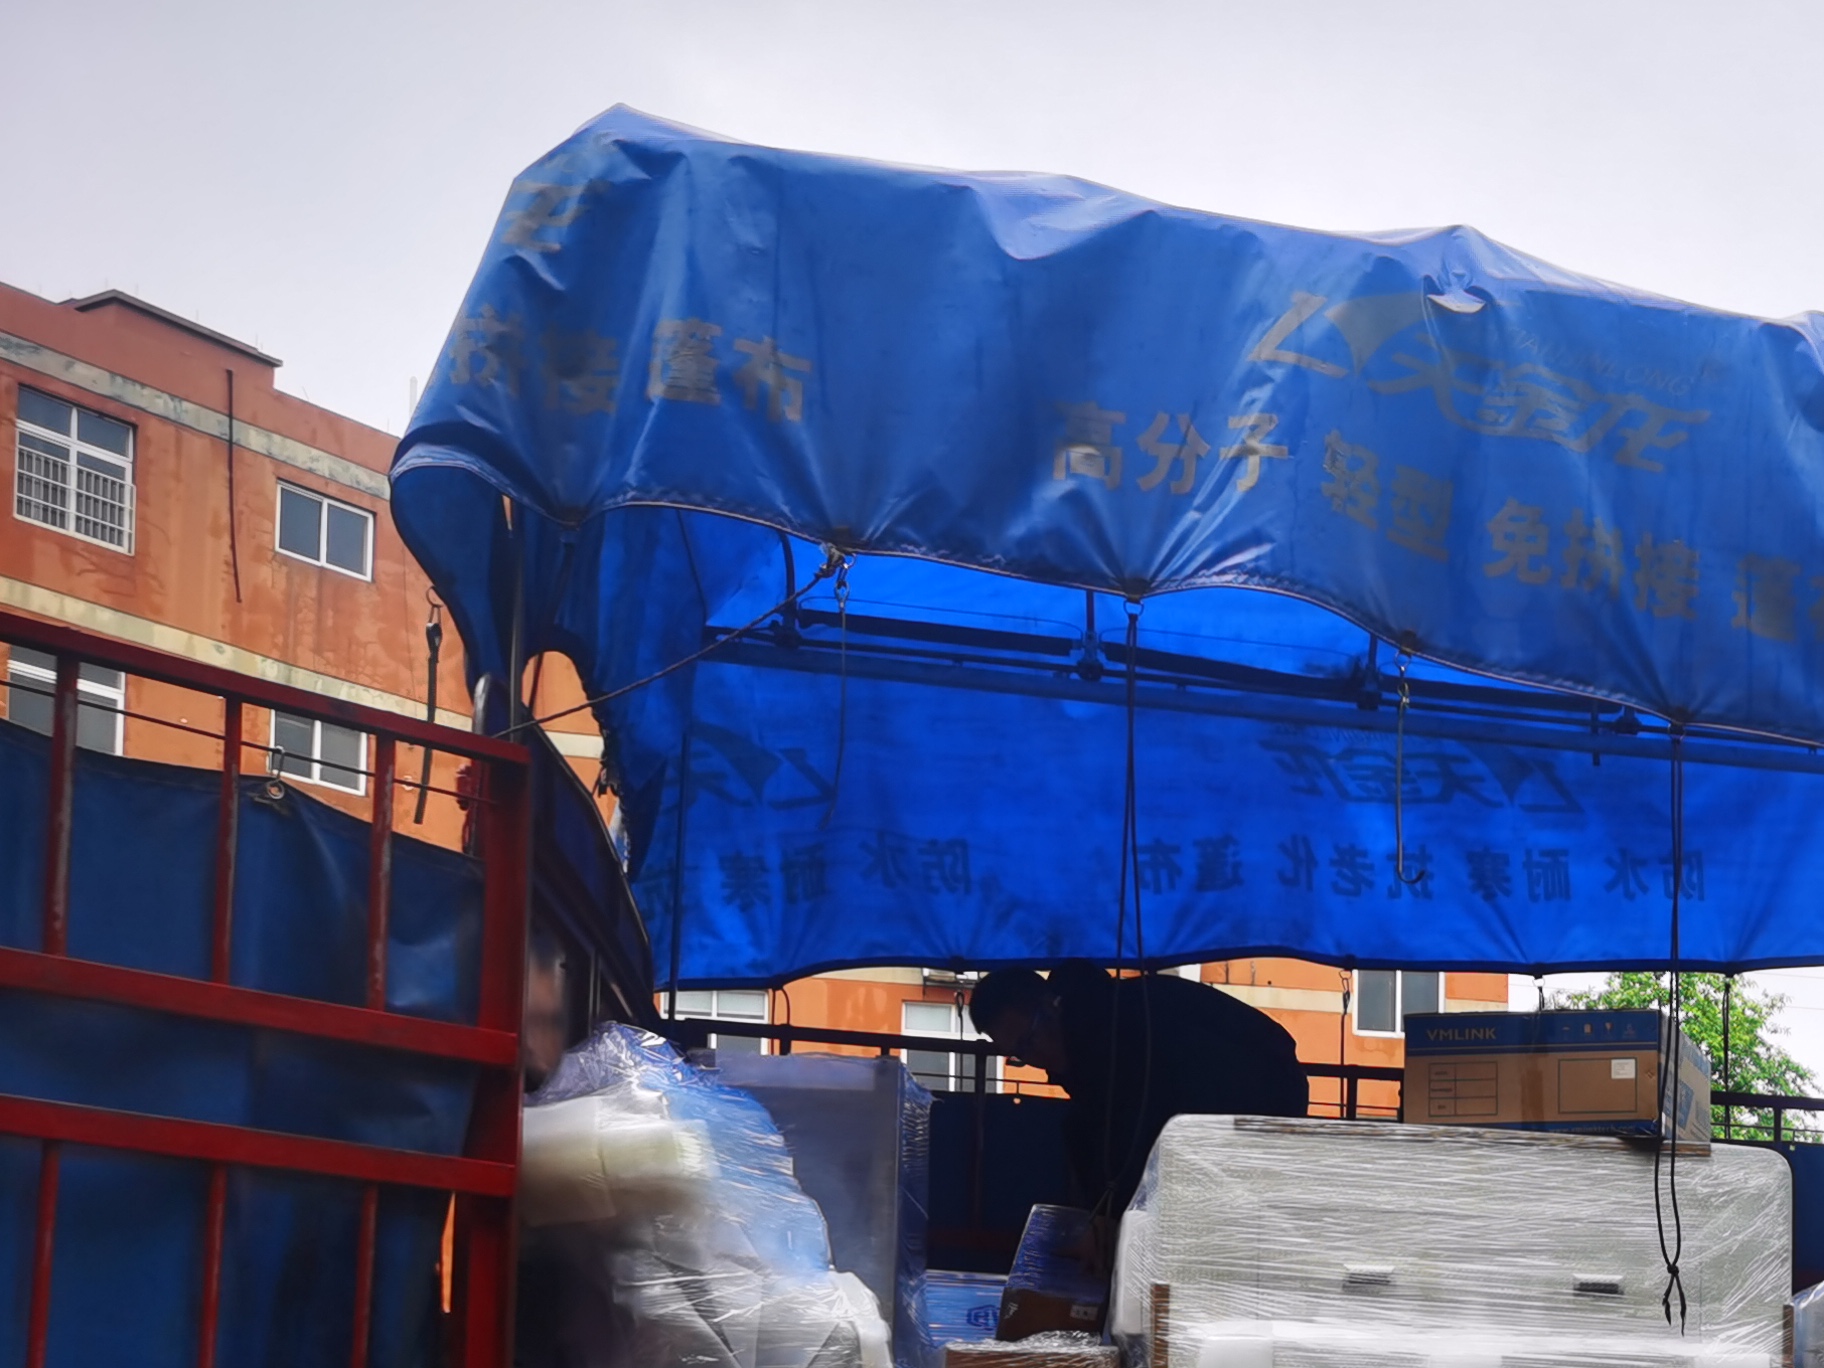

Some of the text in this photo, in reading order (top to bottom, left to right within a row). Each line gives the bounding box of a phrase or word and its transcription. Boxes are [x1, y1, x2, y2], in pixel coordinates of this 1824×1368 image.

[1047, 400, 1290, 497] 高分子
[1320, 427, 1455, 565] 轻型
[1482, 496, 1702, 624] 免拼接
[1426, 1027, 1497, 1042] VMLINK
